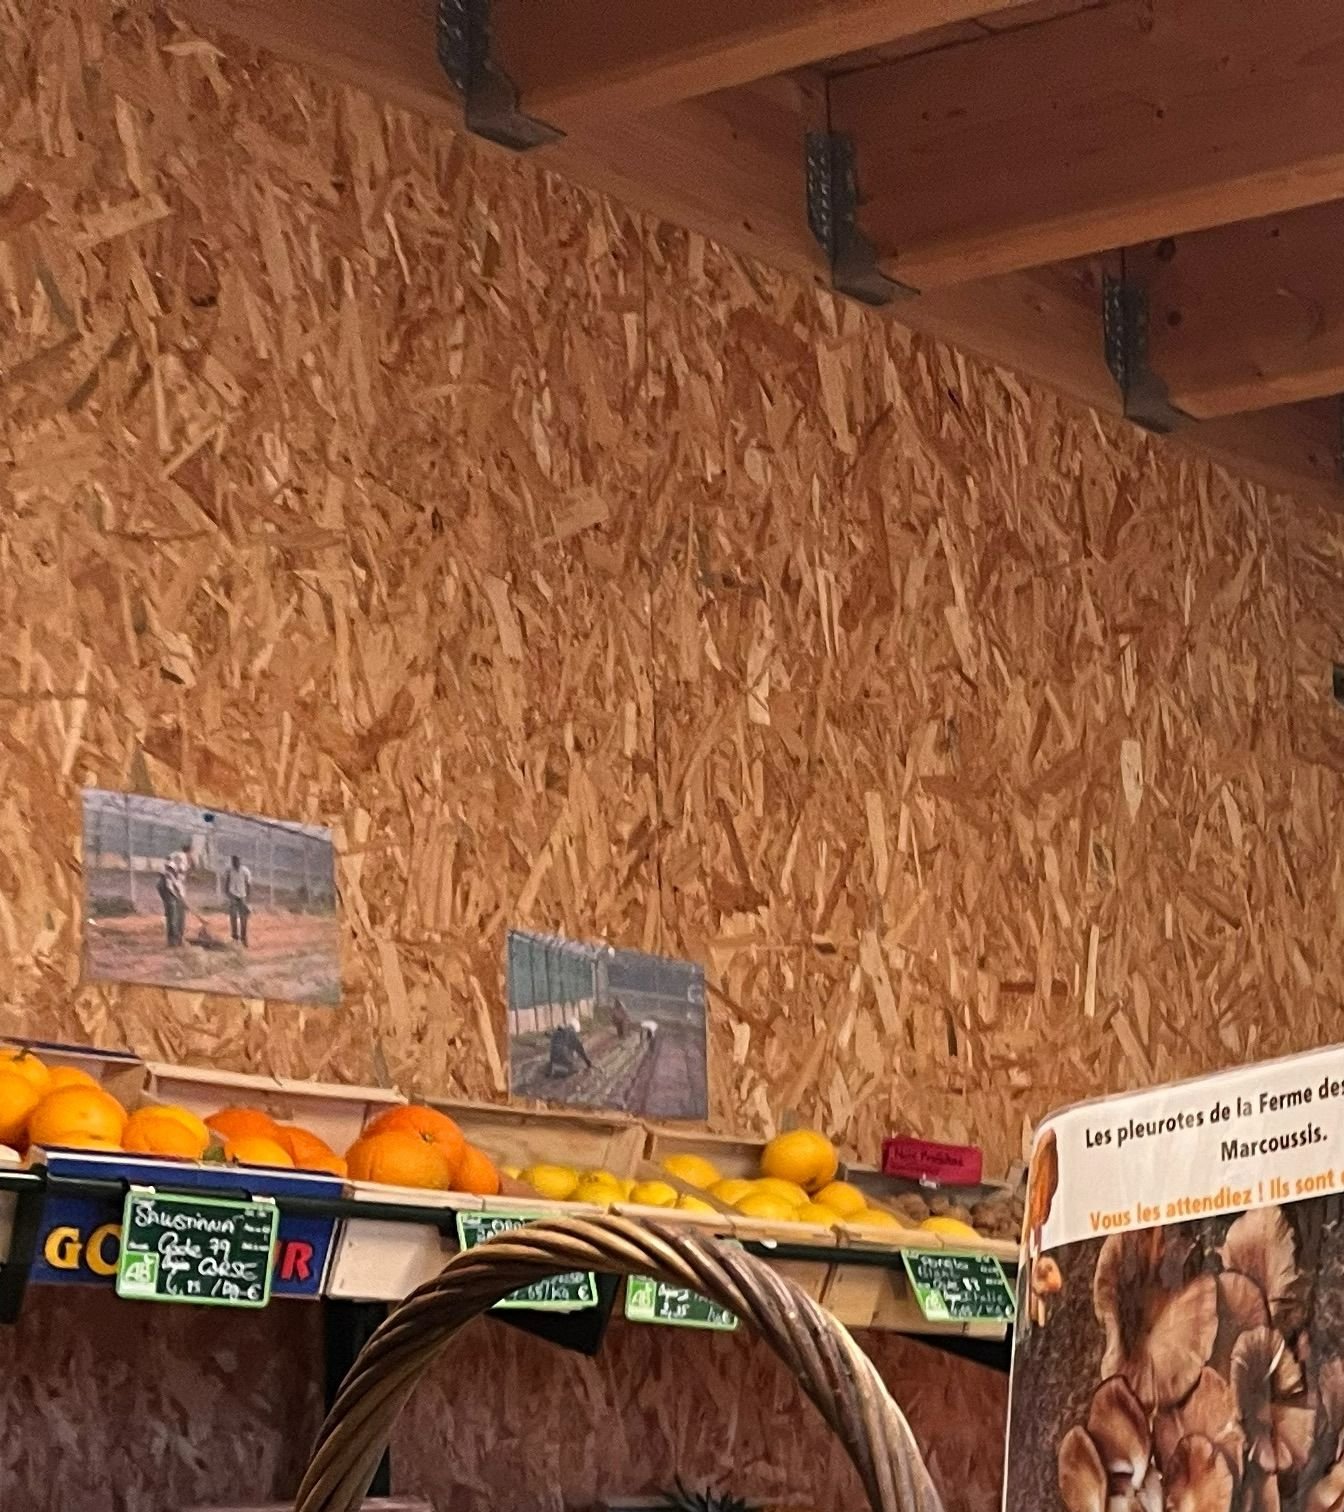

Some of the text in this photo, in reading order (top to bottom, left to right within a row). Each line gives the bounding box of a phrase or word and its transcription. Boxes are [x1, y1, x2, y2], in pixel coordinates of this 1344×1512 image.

[1085, 1128, 1112, 1148] Les
[1117, 1112, 1204, 1147] pleurotes
[1209, 1101, 1231, 1124] de
[1236, 1096, 1253, 1118] la
[1259, 1087, 1313, 1113] Ferme
[1220, 1123, 1328, 1161] Marcoussis.
[1089, 1211, 1132, 1231] Vous
[1136, 1203, 1161, 1223] les
[1166, 1187, 1252, 1217] attendiez
[1269, 1176, 1290, 1199] Ils
[1295, 1169, 1336, 1195] sont
